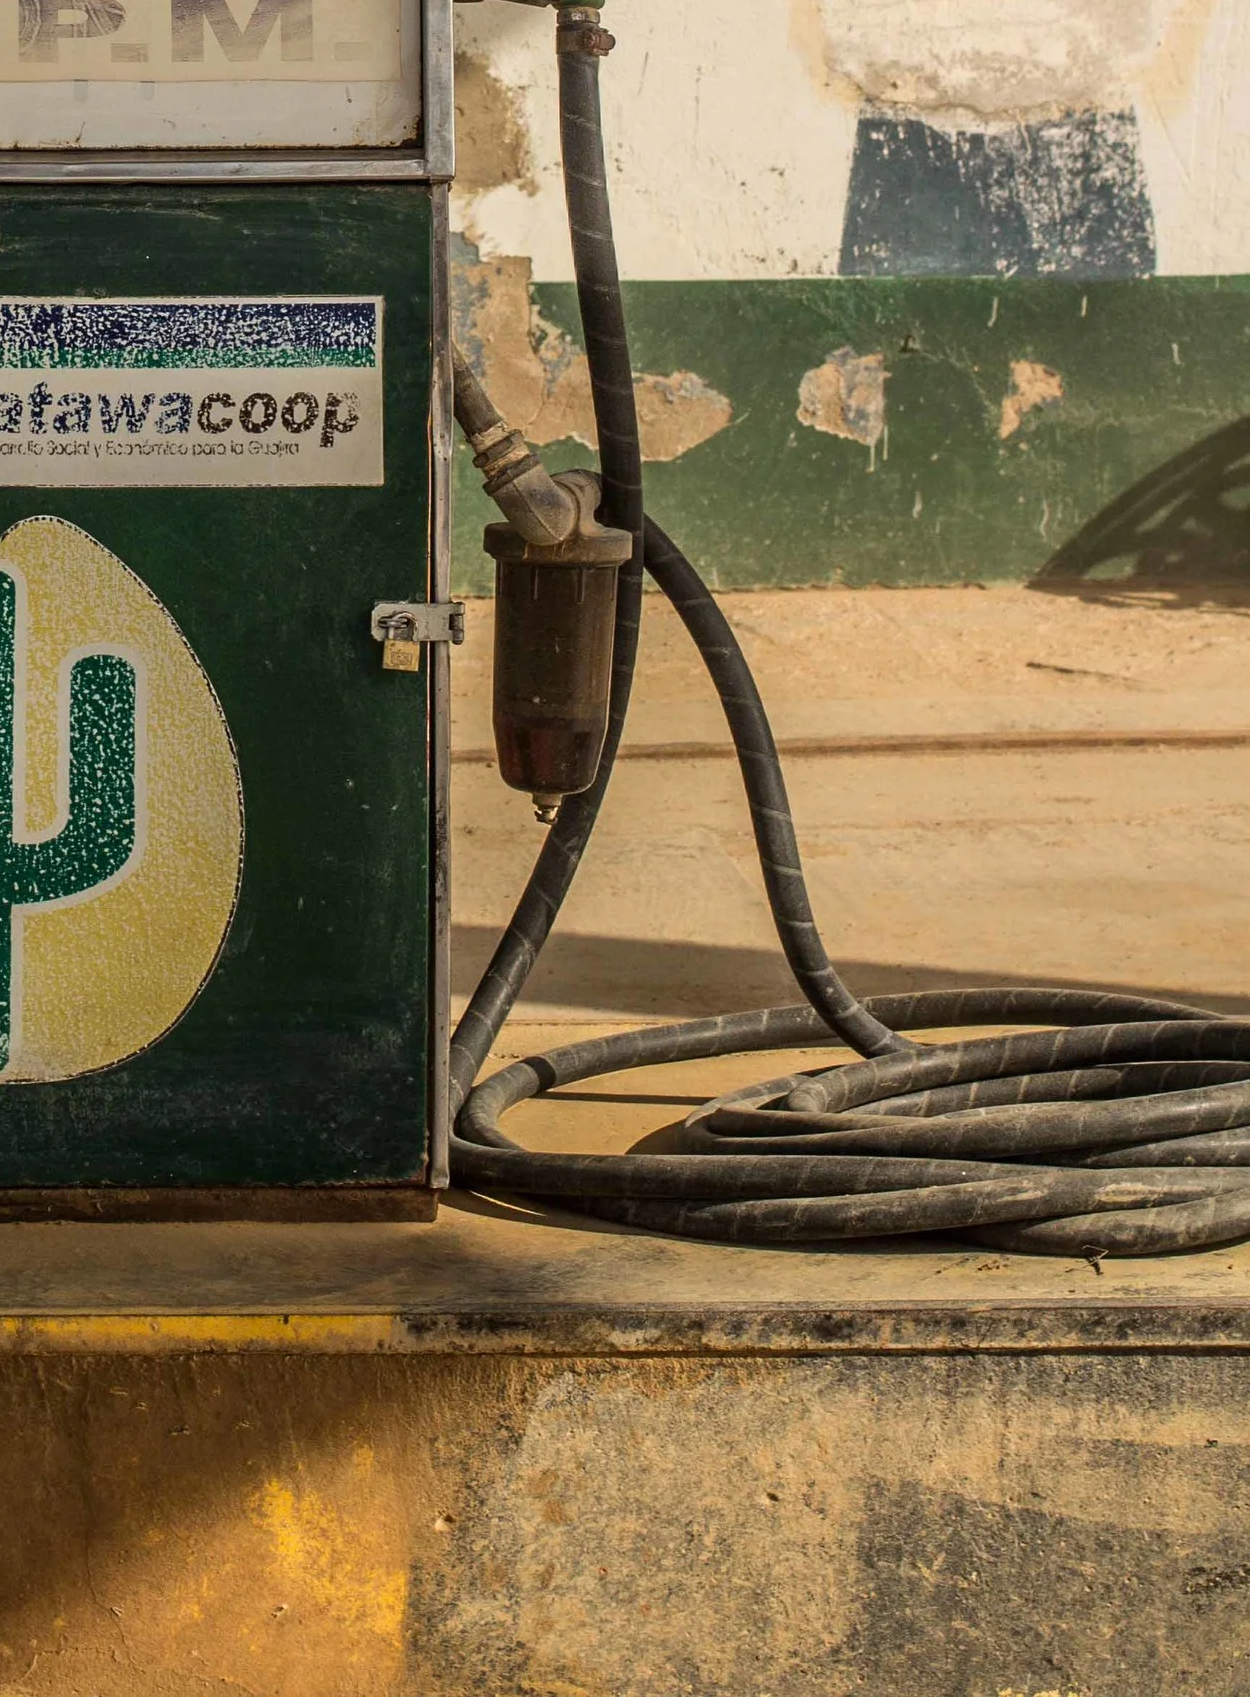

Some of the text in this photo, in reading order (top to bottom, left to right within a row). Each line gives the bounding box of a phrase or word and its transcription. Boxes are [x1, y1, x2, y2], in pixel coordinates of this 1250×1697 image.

[46, 439, 90, 456] Social
[93, 443, 102, 458] y
[105, 438, 189, 456] Económico
[192, 442, 226, 457] para
[230, 439, 244, 456] la
[247, 439, 300, 458] Guajira
